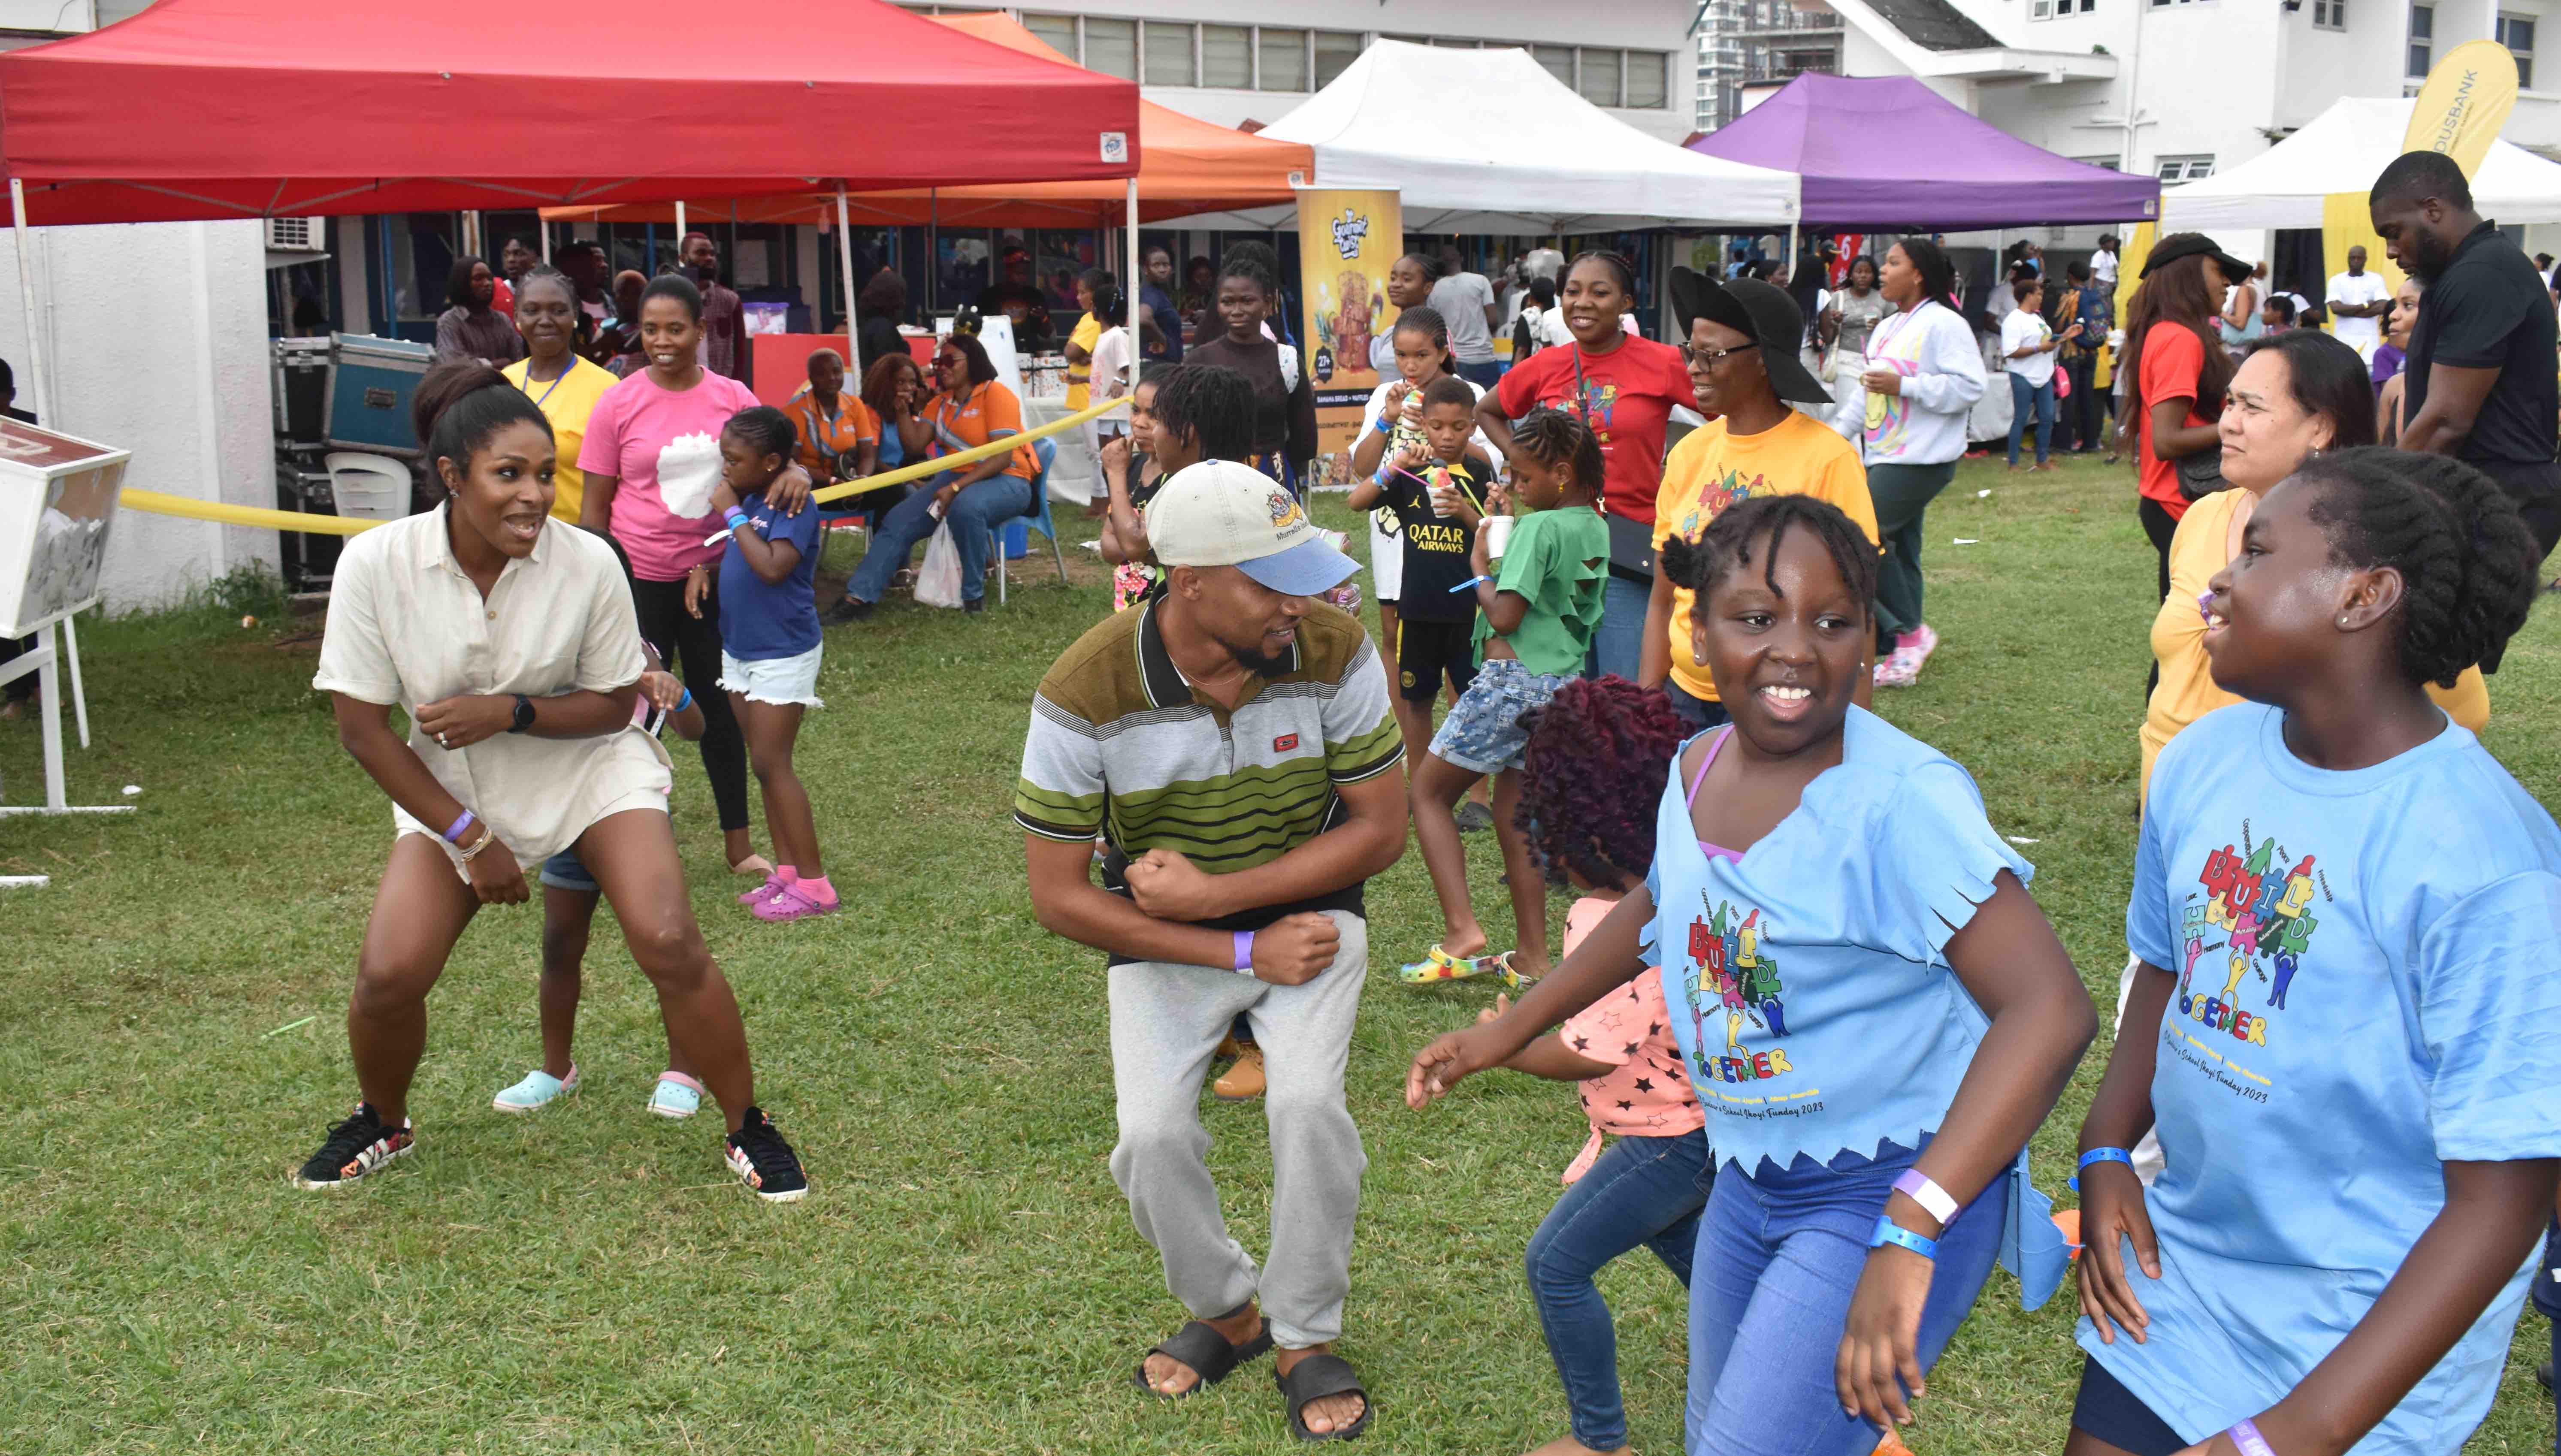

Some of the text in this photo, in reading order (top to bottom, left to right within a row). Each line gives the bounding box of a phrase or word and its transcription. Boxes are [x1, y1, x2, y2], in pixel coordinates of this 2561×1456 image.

[1409, 524, 1463, 543] QATAR
[1417, 541, 1464, 553] AIRWAYS
[2211, 855, 2307, 939] BUILD
[1695, 927, 1772, 983] BUILD
[1693, 1048, 1793, 1083] TOGETHER
[2181, 1049, 2200, 1068] School
[2216, 1070, 2242, 1096] Funday
[2243, 1086, 2268, 1104] 2023
[1766, 1108, 1799, 1119] Funday
[1801, 1101, 1823, 1114] 2023
